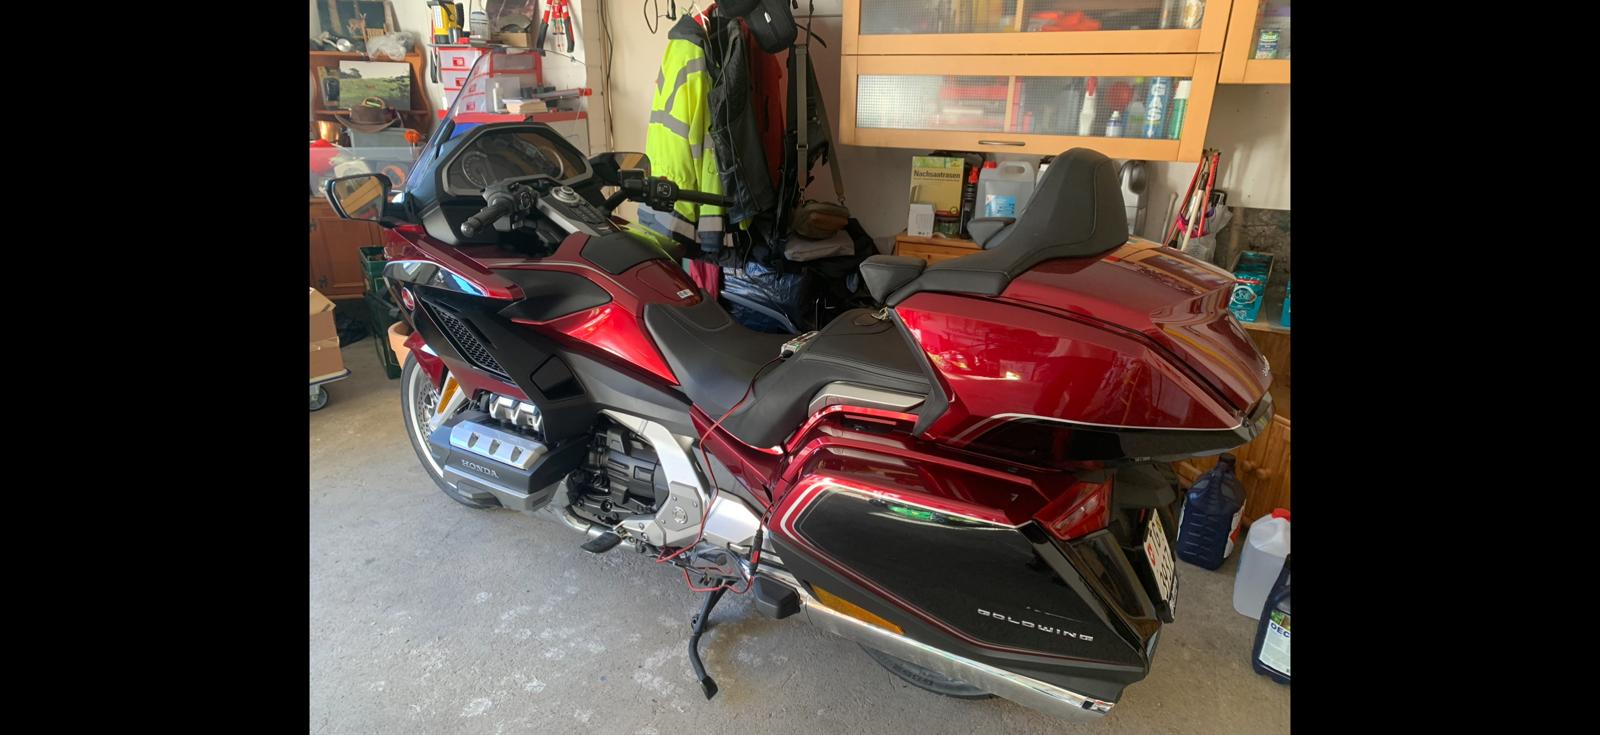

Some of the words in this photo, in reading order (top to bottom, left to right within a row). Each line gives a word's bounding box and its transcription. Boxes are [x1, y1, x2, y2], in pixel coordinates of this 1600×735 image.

[913, 169, 960, 178] Nachsaatrasen
[462, 460, 499, 479] HONDA
[977, 608, 1094, 642] GOLDWING
